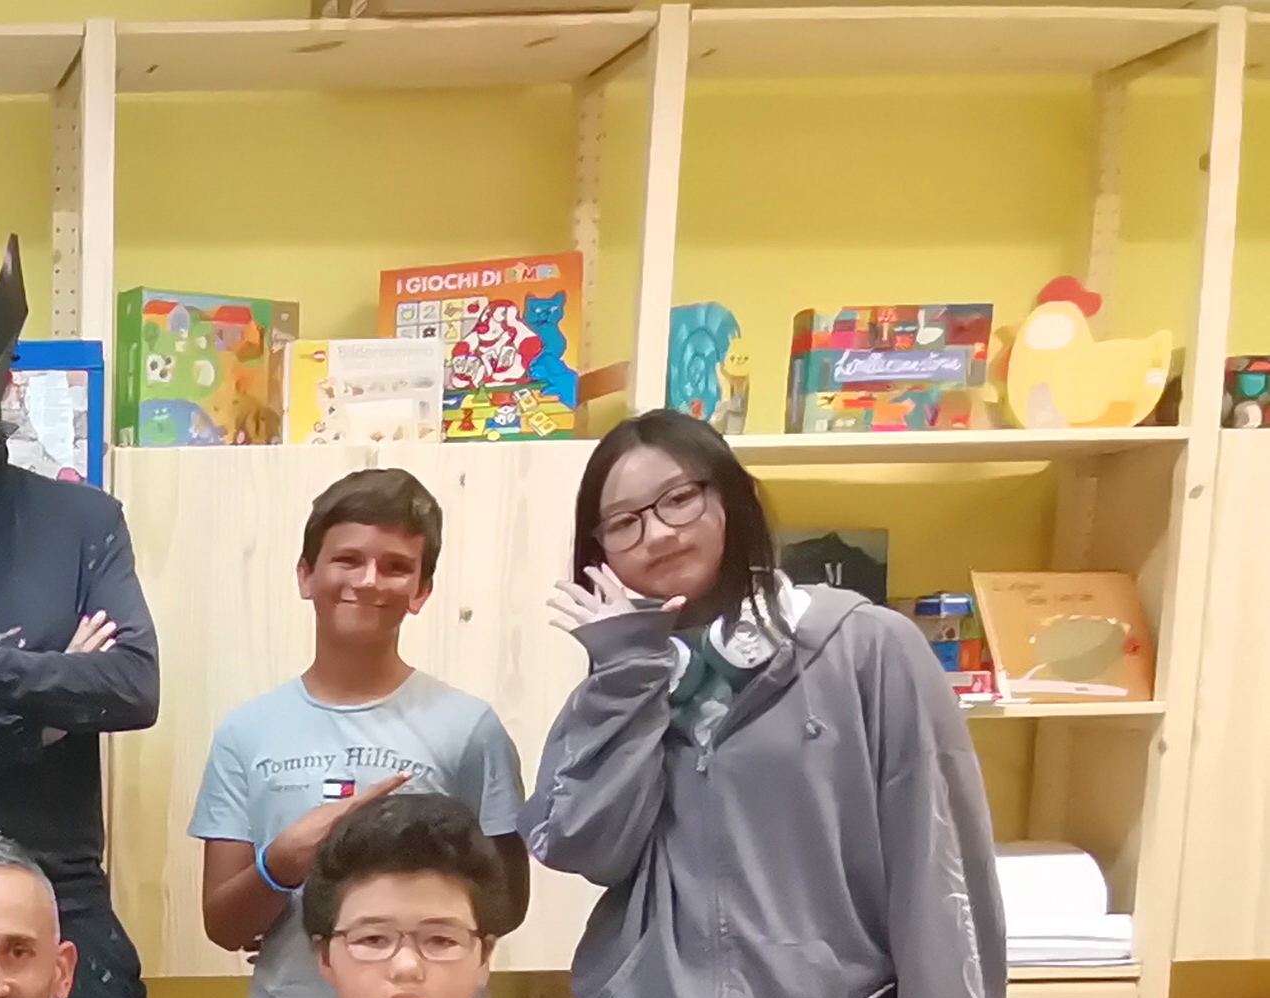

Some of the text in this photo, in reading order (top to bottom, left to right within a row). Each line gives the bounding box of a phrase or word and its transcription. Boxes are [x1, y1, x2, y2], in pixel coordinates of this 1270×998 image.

[397, 279, 402, 294] I
[405, 271, 477, 293] GIOCHI
[482, 271, 501, 286] DI
[256, 747, 436, 778] Tommy Hilfiger
